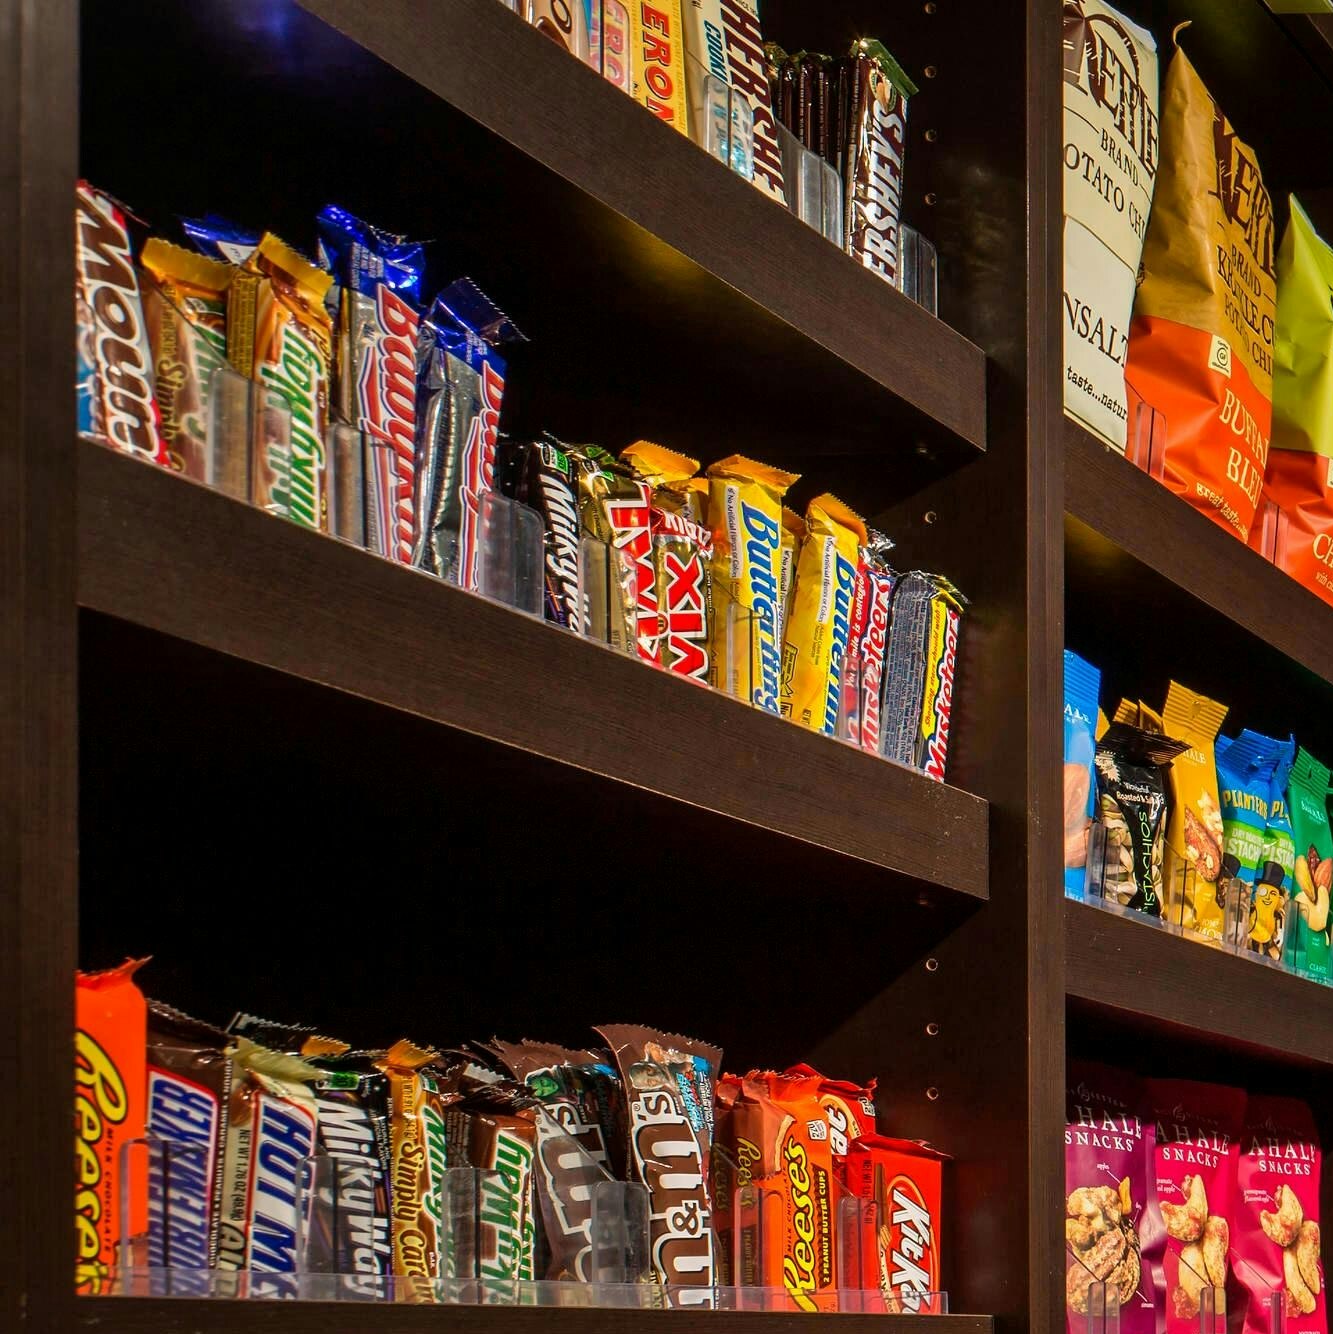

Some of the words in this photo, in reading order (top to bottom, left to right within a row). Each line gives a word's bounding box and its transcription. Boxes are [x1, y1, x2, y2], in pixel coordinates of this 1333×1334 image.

[1101, 128, 1139, 187] BRAND
[1064, 144, 1125, 212] OTATO
[537, 473, 579, 582] Milky
[1222, 789, 1268, 821] PLANTERS
[1064, 1130, 1135, 1152] SNACKS
[1065, 1104, 1143, 1140] HALE
[316, 1098, 381, 1216] Milky
[1162, 1147, 1219, 1168] SNACKS
[1259, 1159, 1311, 1177] SNACKS
[393, 1143, 426, 1221] Simply
[817, 1169, 827, 1195] CUPS
[783, 1137, 818, 1313] Reese's
[819, 1198, 829, 1234] BUTTER
[343, 1215, 391, 1298] Way
[821, 1237, 830, 1275] PEANUT
